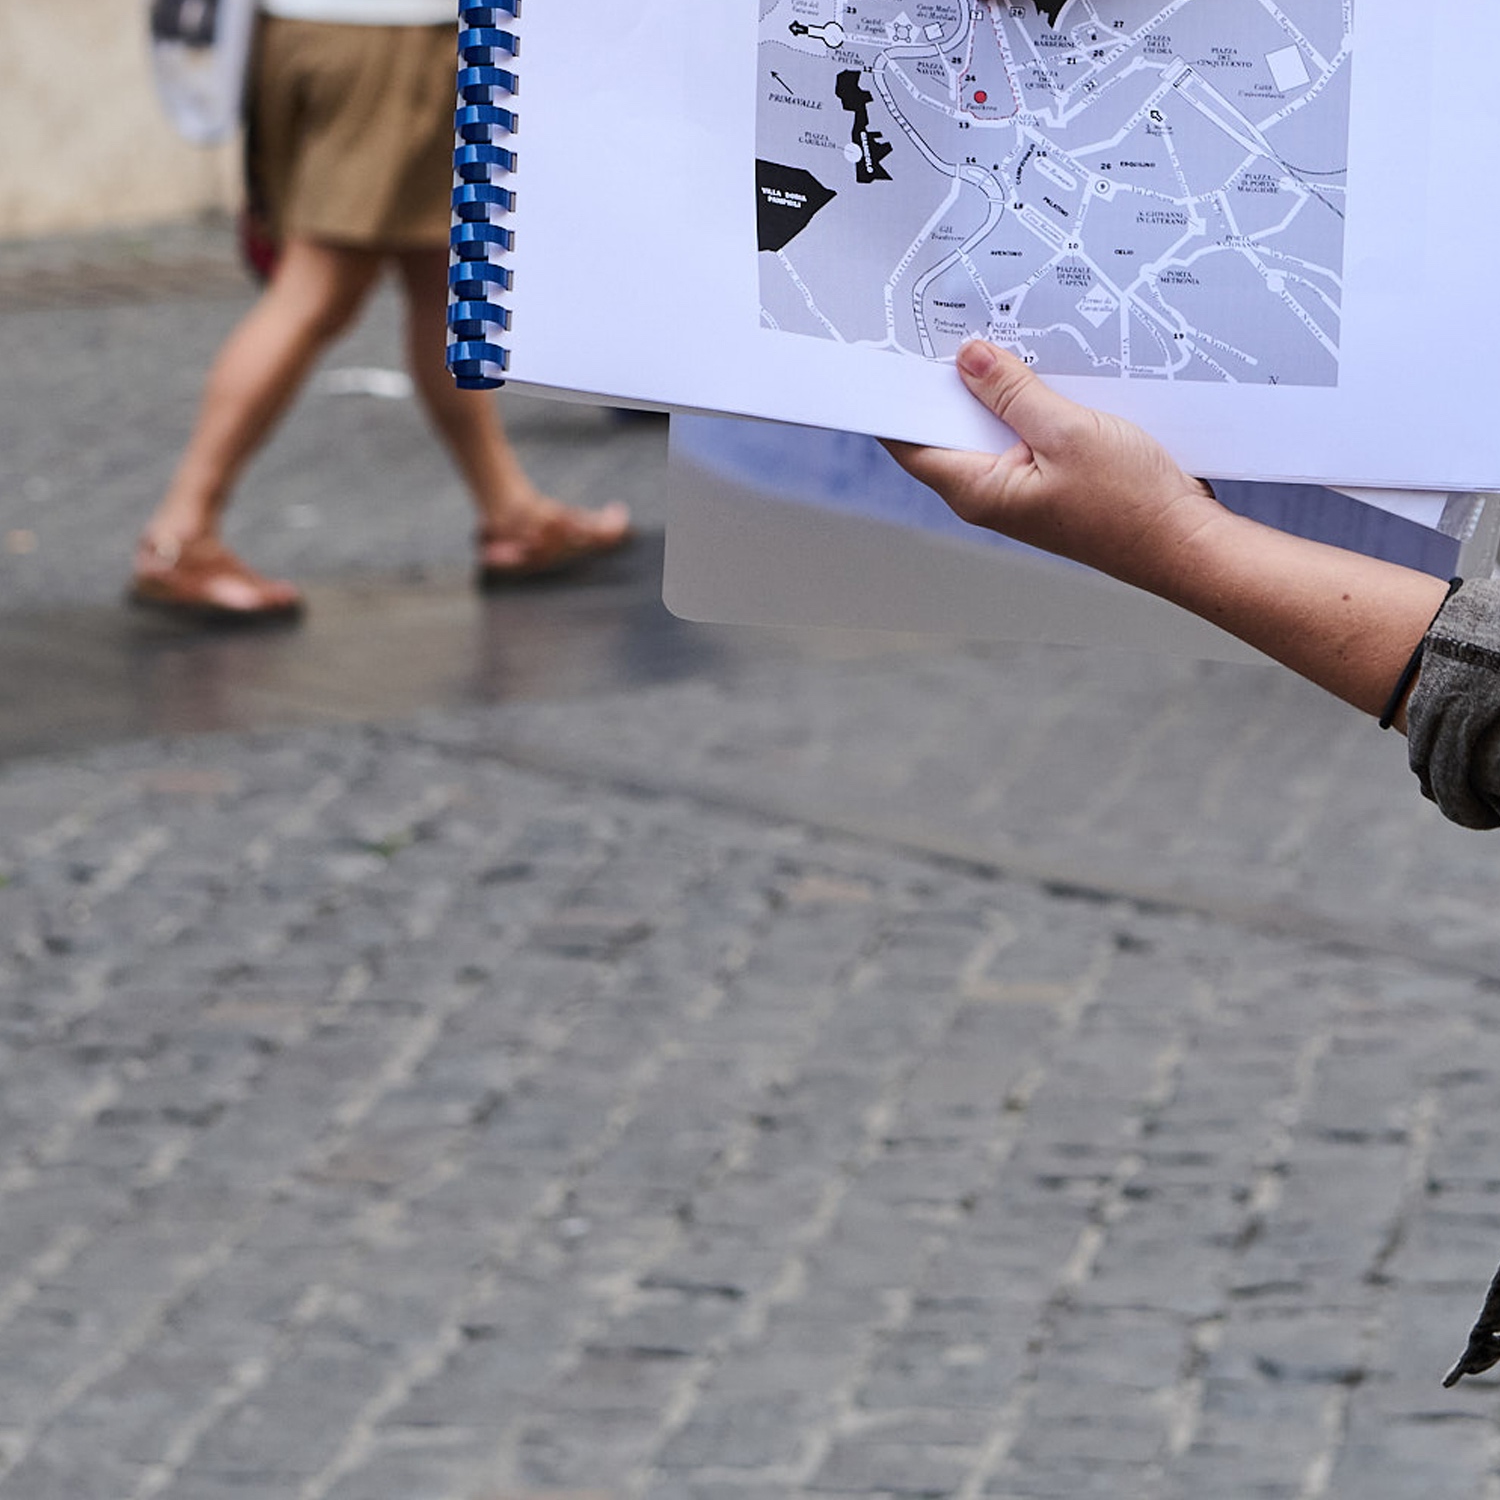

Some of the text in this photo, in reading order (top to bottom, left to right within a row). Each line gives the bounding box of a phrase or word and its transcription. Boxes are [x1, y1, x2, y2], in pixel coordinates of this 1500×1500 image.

[1040, 34, 1067, 42] PIAZZA
[1211, 47, 1238, 57] PIAZZA
[917, 62, 944, 72] PIAZZA
[768, 92, 824, 111] PRIMAVALLE
[804, 130, 830, 141] PIAZZA
[761, 186, 782, 198] VILLA
[1166, 270, 1193, 279] PORTA
